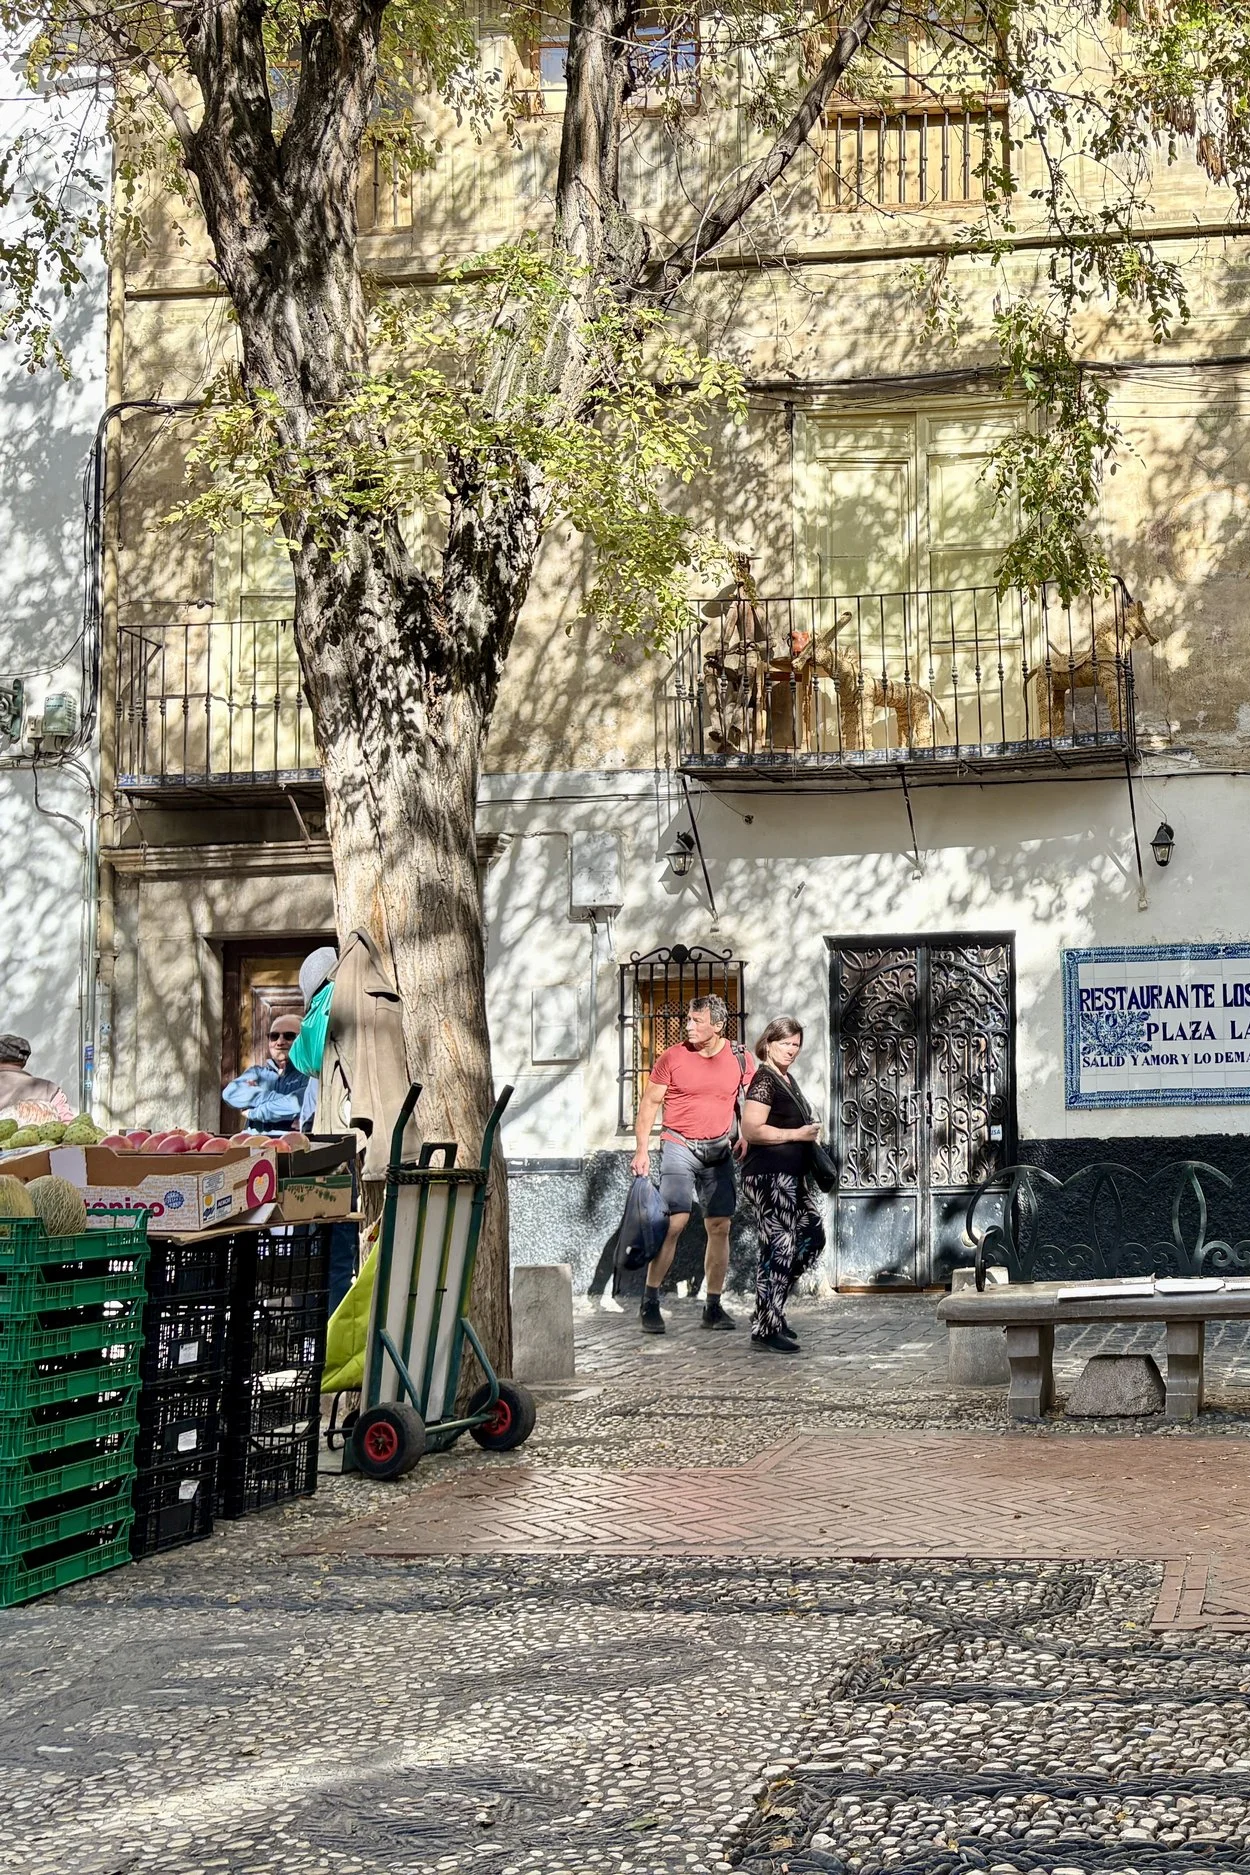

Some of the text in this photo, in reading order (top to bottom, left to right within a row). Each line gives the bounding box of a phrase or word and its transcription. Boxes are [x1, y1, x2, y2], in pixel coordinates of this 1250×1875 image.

[1079, 983, 1215, 1012] RESTAURANTE
[1146, 1020, 1217, 1041] PLAZA
[1082, 1055, 1125, 1068] SALUD
[1131, 1054, 1139, 1066] Y
[1141, 1053, 1179, 1066] AMOR
[1181, 1053, 1190, 1065] Y
[1194, 1052, 1212, 1065] LO
